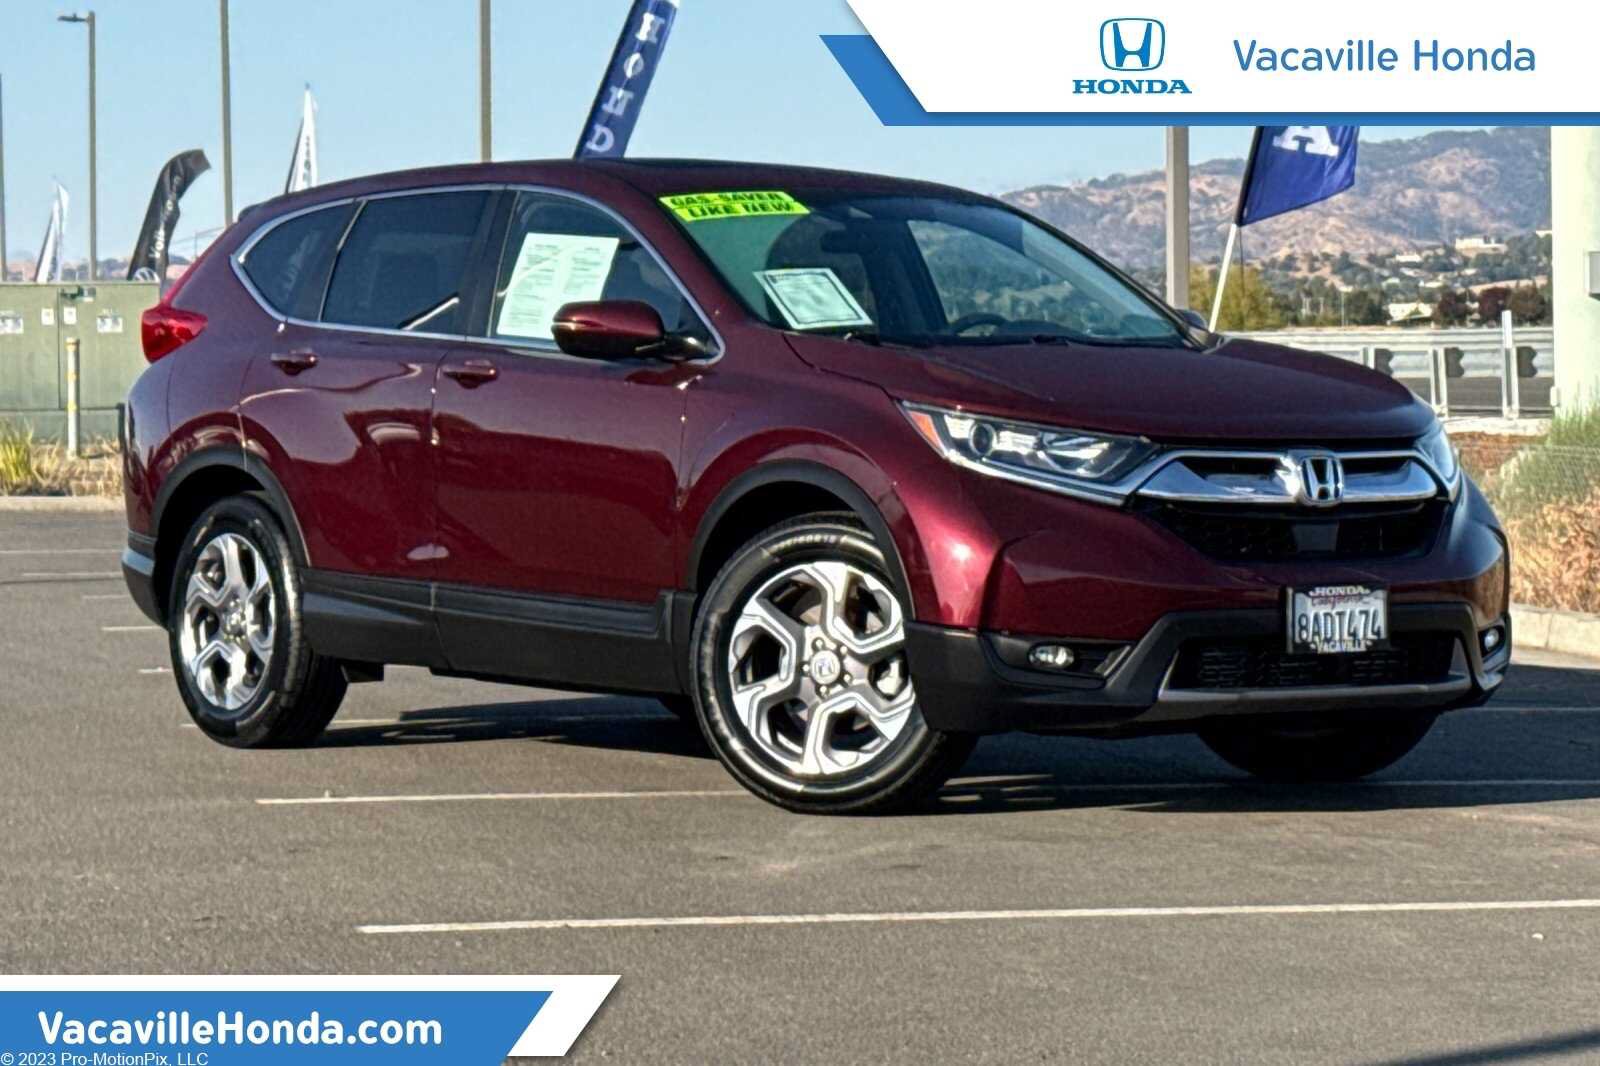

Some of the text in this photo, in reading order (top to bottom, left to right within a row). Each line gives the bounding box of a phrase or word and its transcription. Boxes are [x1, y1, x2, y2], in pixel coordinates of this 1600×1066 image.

[670, 191, 782, 207] GAS SAVER
[687, 204, 735, 218] LIKE
[1313, 585, 1367, 597] HONDA
[1298, 609, 1383, 641] 8ADT474
